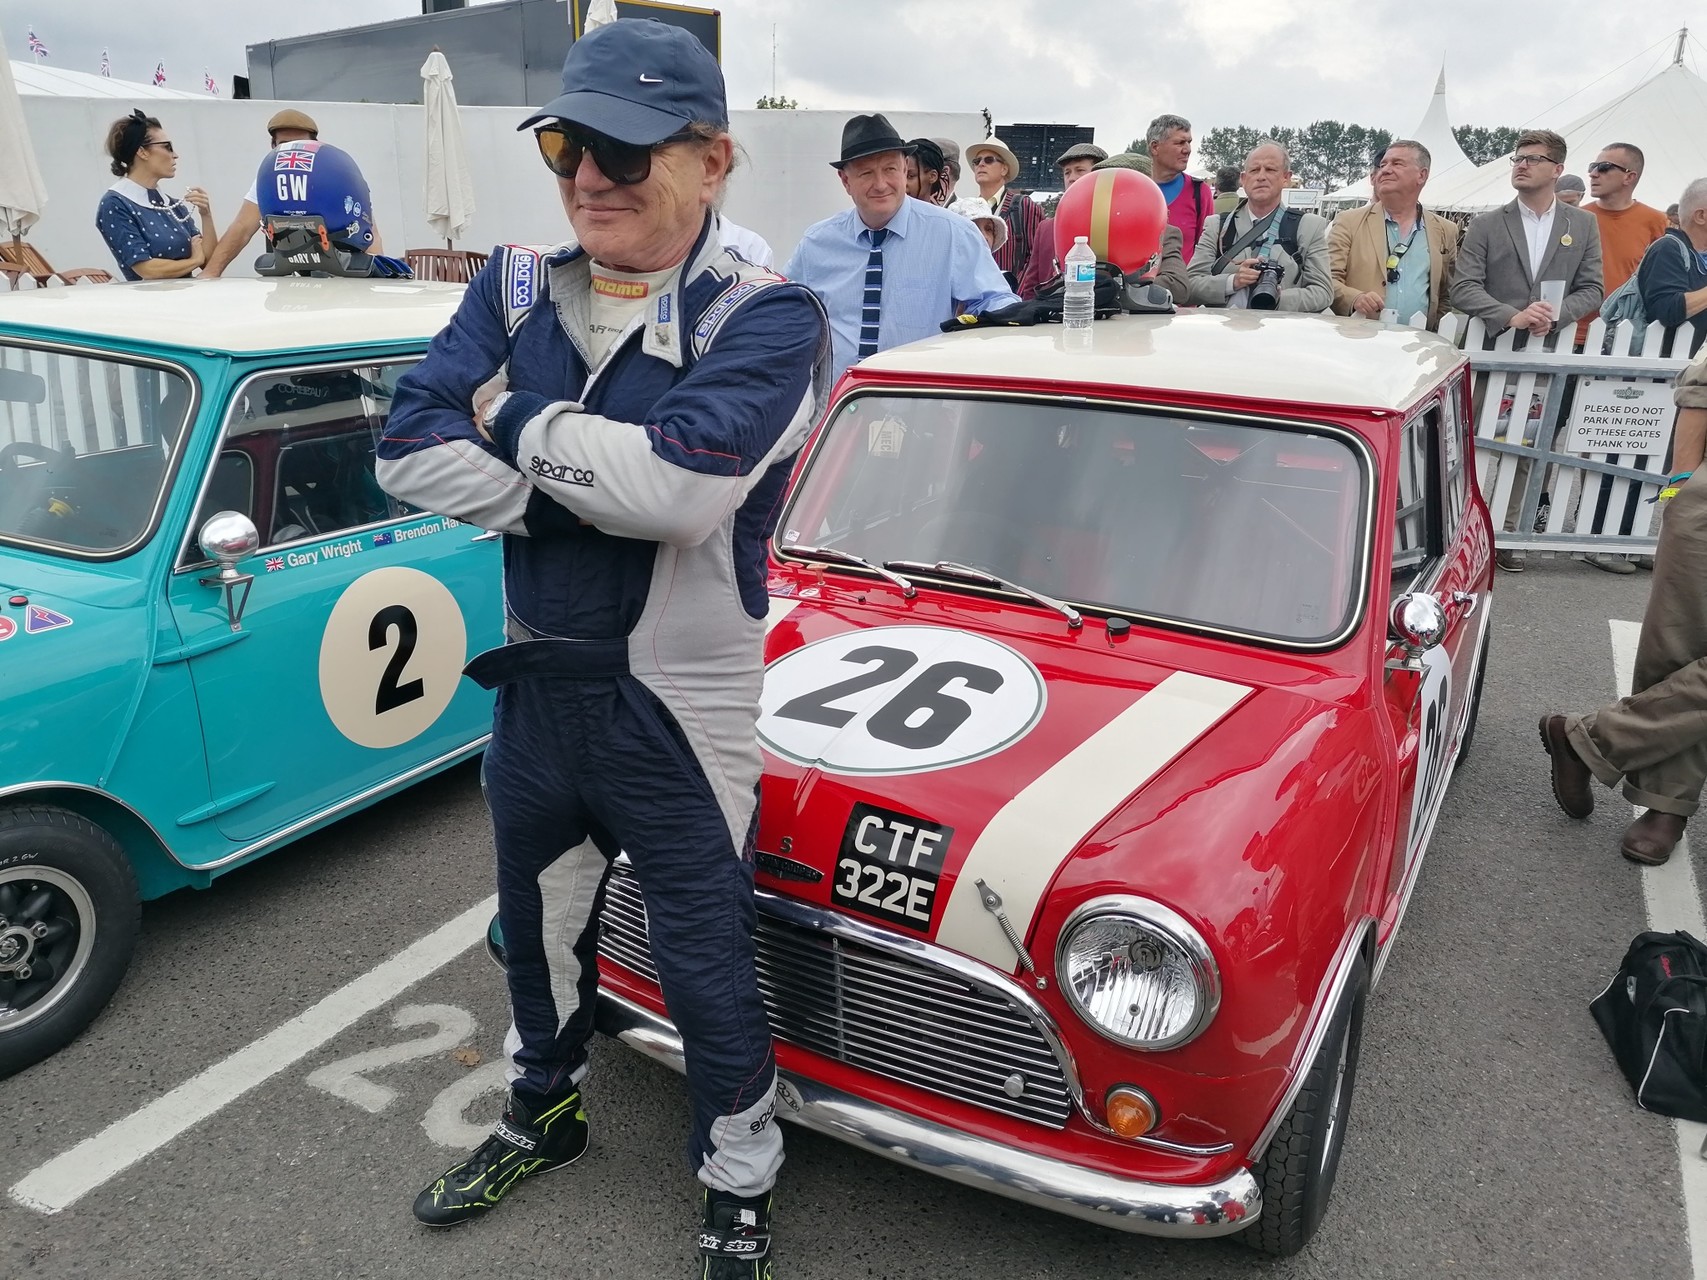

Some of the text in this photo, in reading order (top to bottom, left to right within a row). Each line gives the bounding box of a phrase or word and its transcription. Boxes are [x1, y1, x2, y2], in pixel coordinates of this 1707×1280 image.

[276, 173, 308, 202] GW
[310, 252, 321, 264] W
[514, 254, 532, 307] sparco
[593, 278, 645, 296] momo
[698, 283, 754, 335] sparco
[1583, 404, 1665, 415] PLEASE DO NOT
[1583, 416, 1661, 427] PARK IN FRONT
[1577, 427, 1661, 439] OF THESE GATES
[1587, 439, 1648, 449] THANK YOU
[529, 455, 595, 487] sparco
[394, 516, 465, 543] Brendon Har
[287, 539, 363, 568] Gary Wright
[368, 604, 425, 716] 2
[772, 645, 1005, 750] 26
[779, 835, 794, 854] S
[854, 815, 943, 868] CTF
[21, 852, 39, 861] GW
[835, 858, 936, 922] 322E
